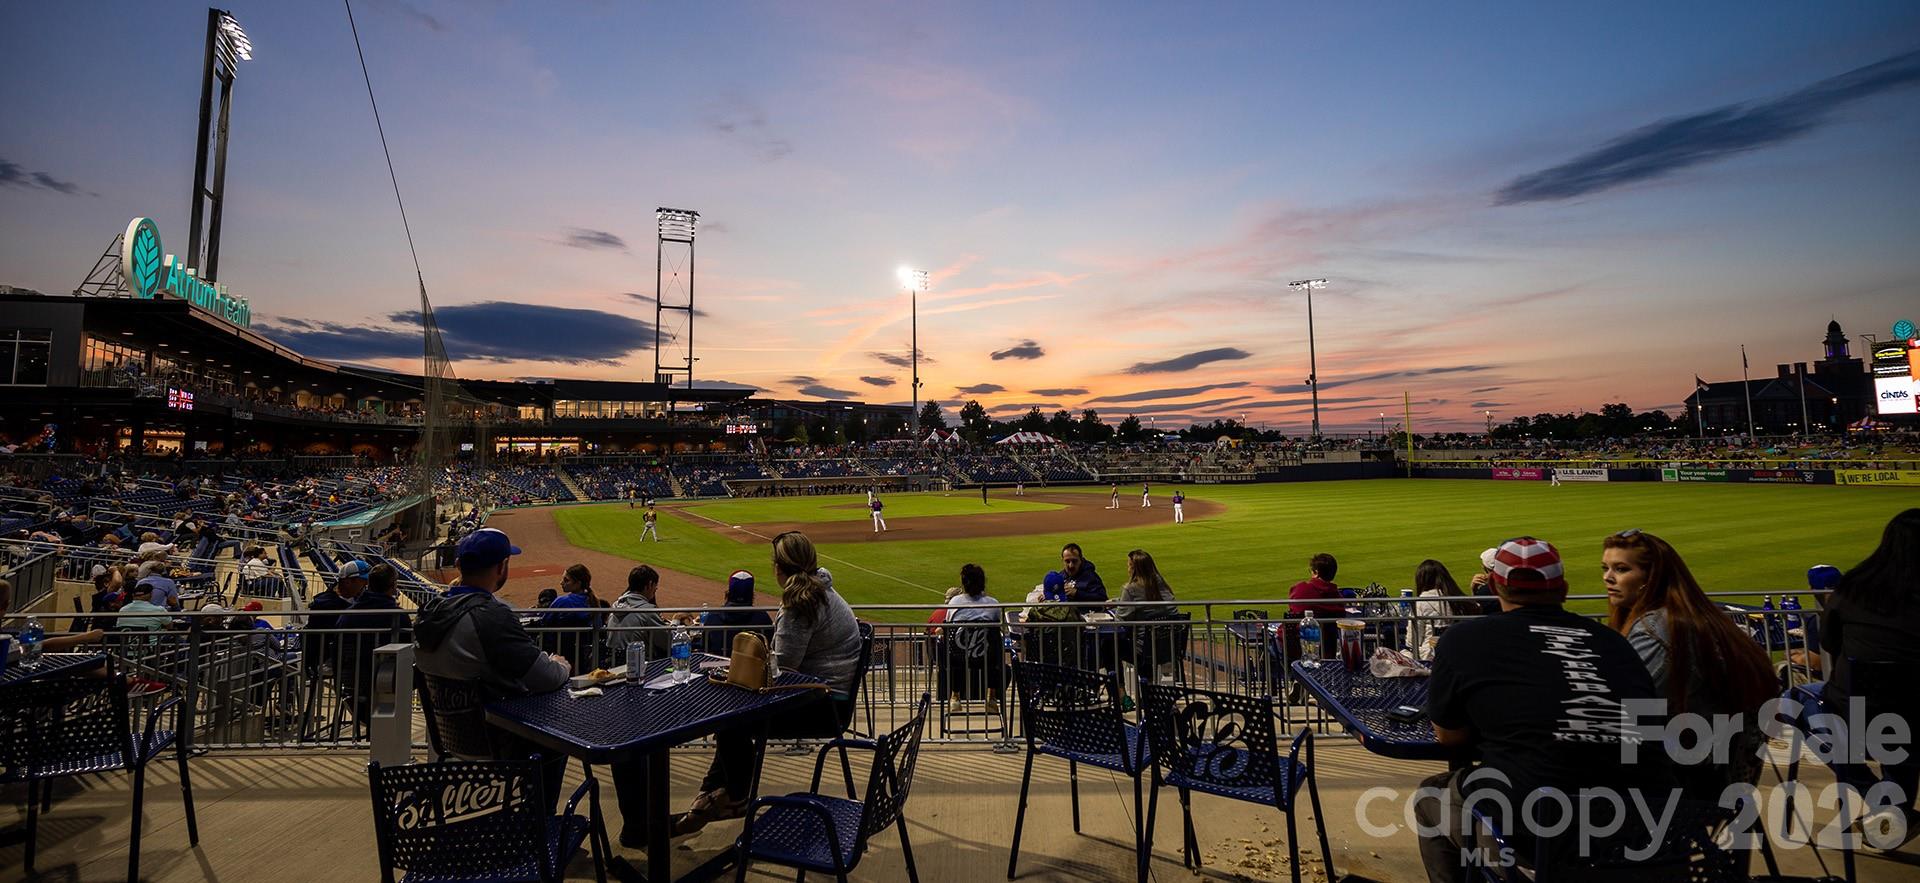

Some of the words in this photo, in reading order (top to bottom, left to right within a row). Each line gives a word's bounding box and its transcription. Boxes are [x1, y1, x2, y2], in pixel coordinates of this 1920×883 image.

[166, 255, 217, 313] Atrium
[218, 293, 251, 328] Health
[1847, 473, 1872, 483] WE'RE
[1874, 471, 1900, 482] LOCAL
[1552, 732, 1644, 745] KREW
